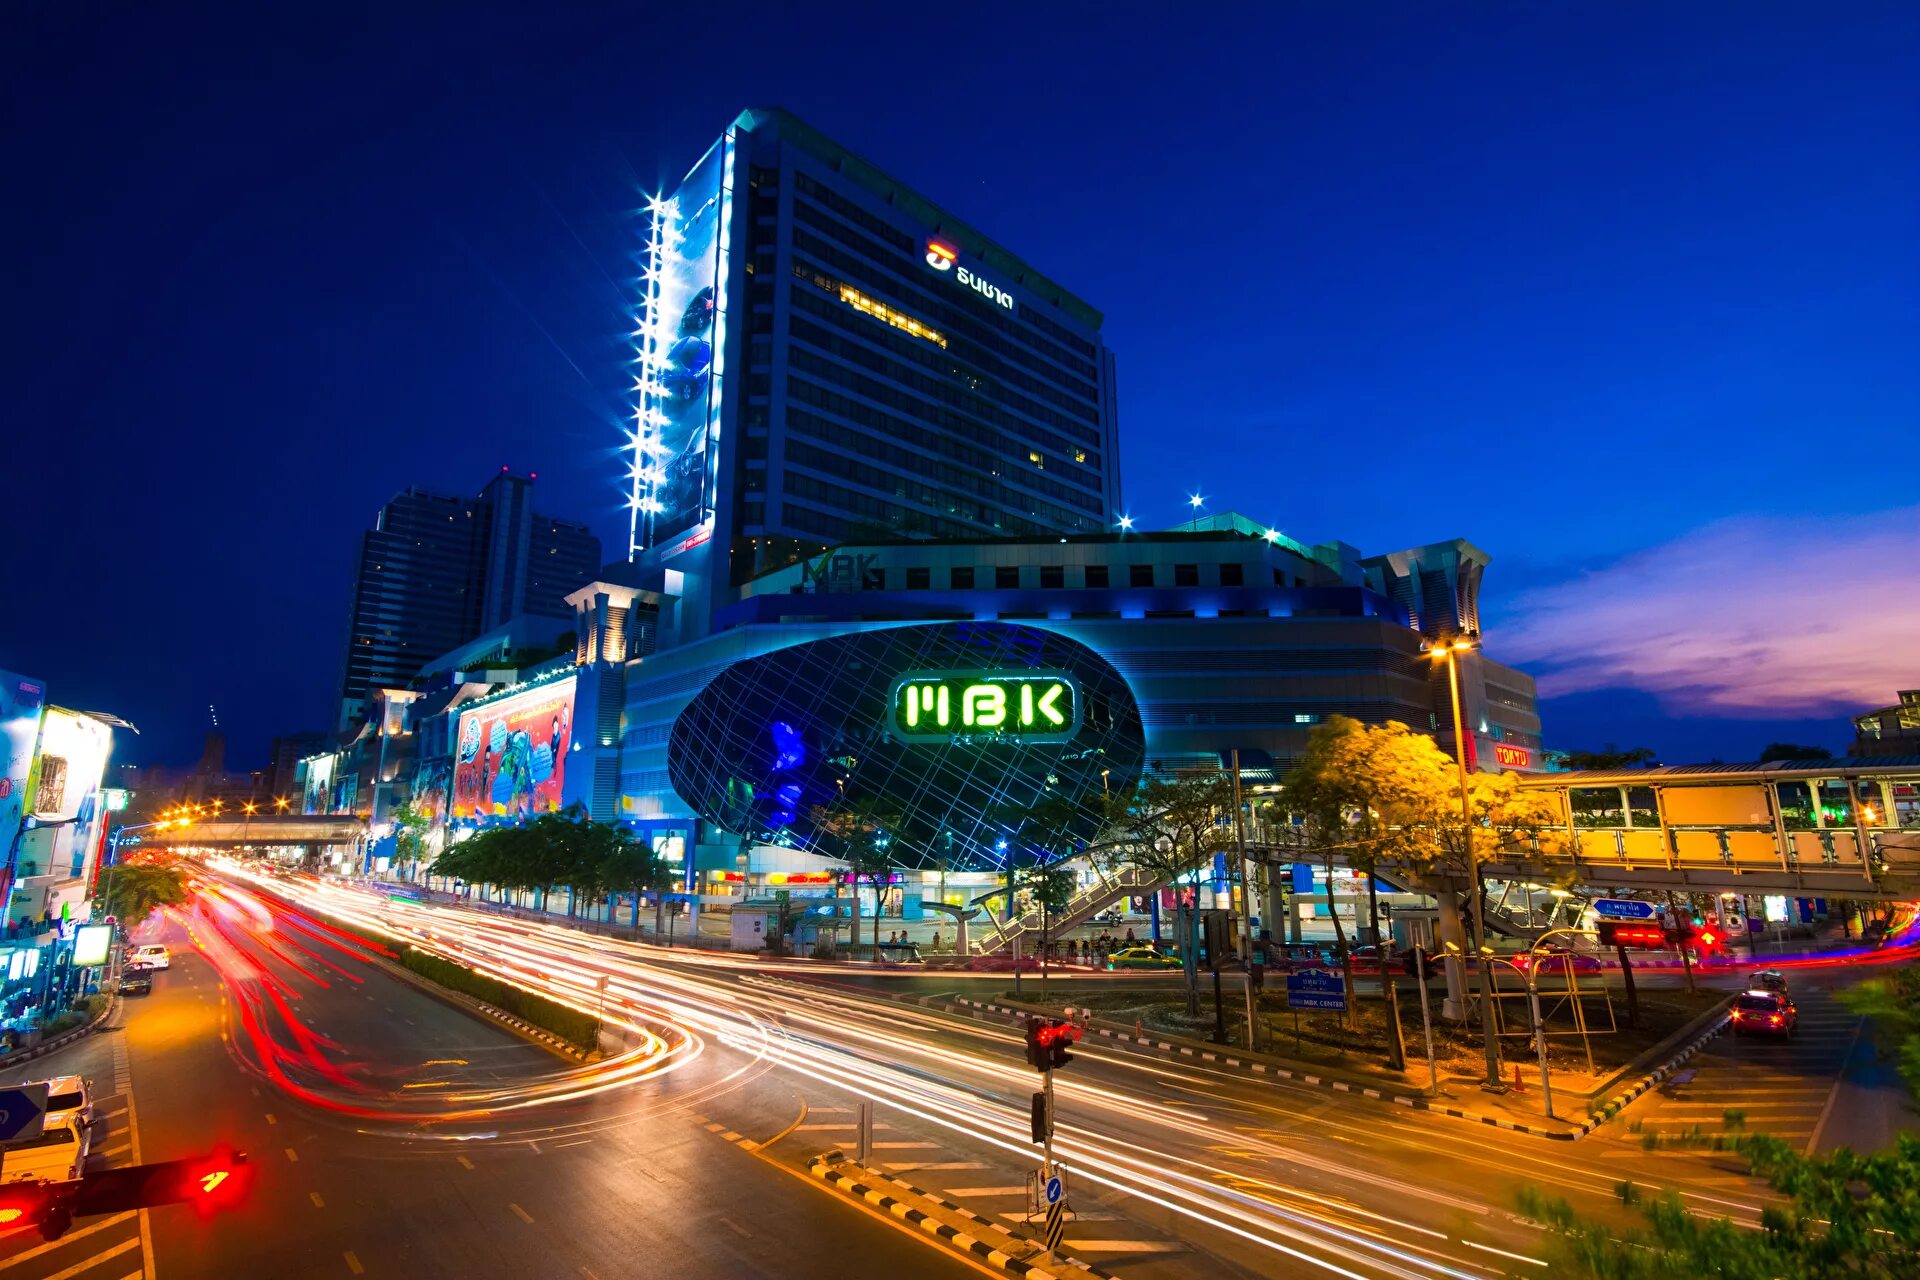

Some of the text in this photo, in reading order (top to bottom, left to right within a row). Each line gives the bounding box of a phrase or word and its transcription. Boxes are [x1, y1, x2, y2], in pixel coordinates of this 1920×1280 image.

[957, 266, 1013, 310] ธนชาต
[803, 548, 881, 583] MBK
[906, 684, 1064, 727] MBK
[1496, 747, 1527, 766] TOKYU
